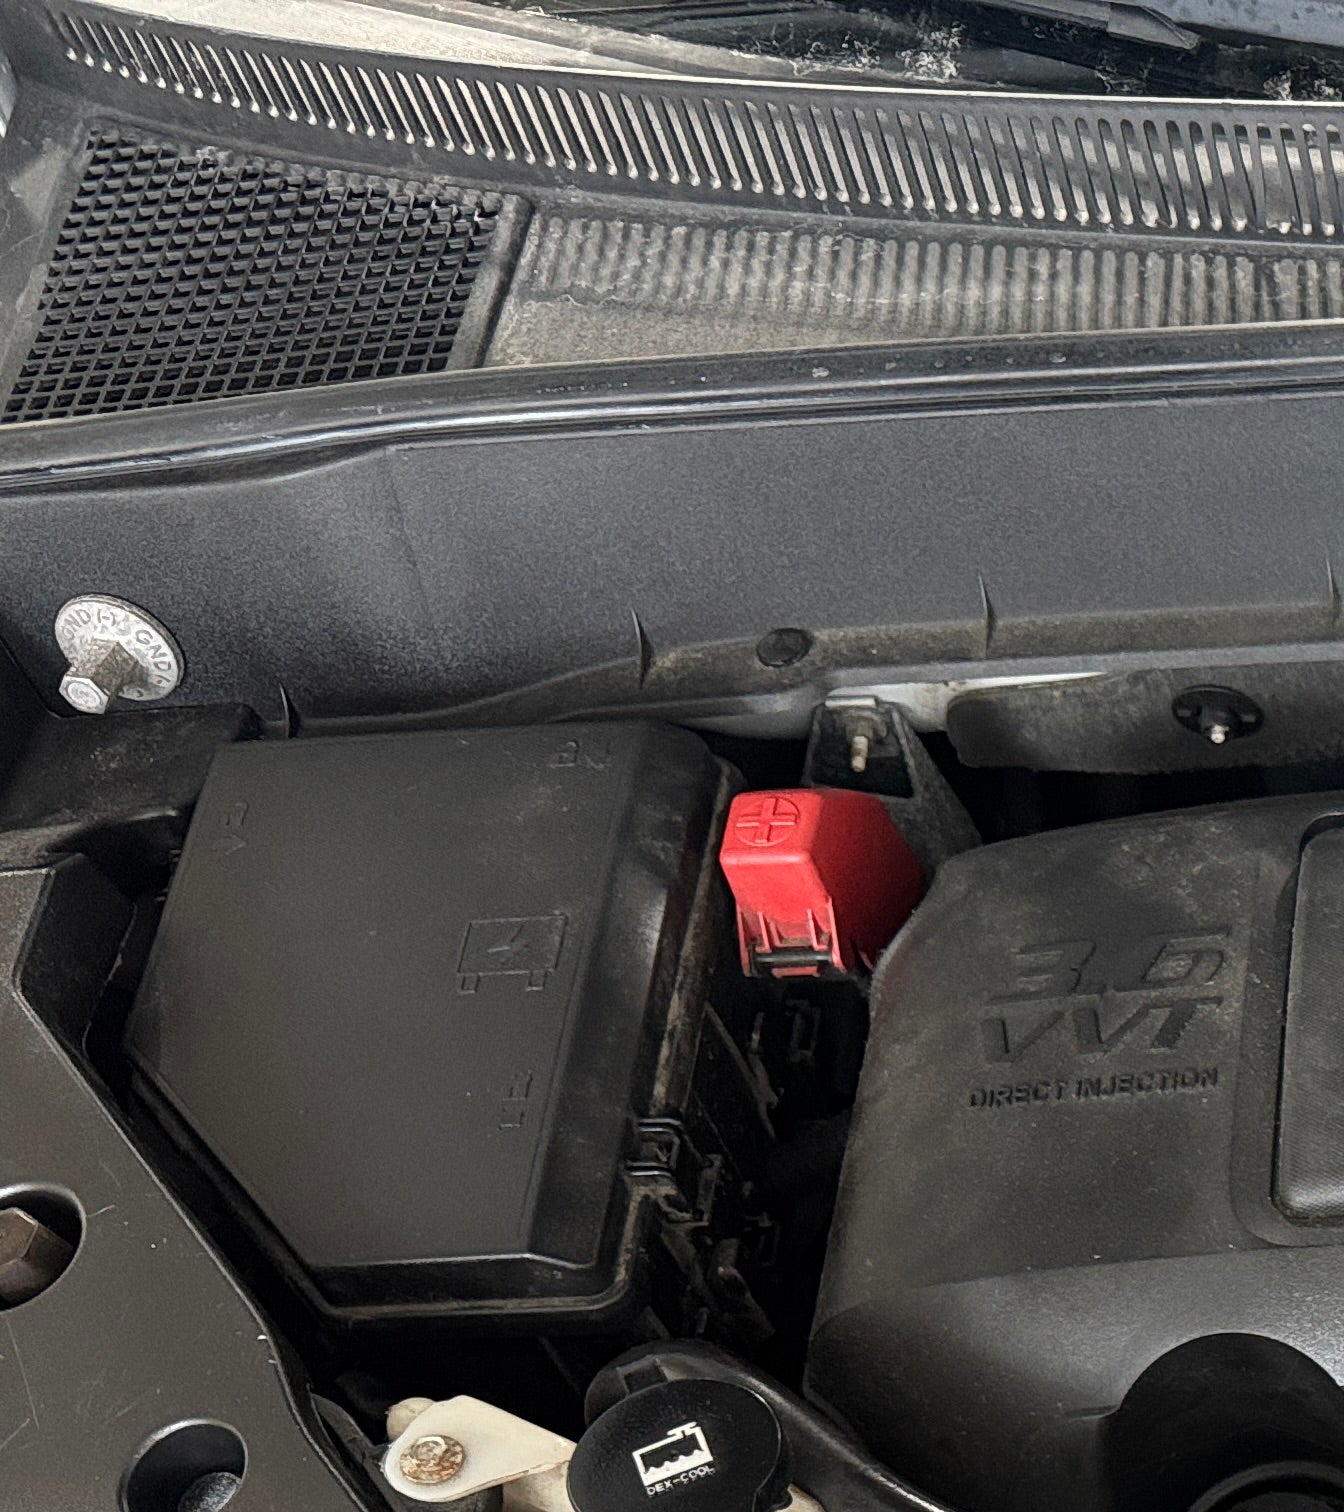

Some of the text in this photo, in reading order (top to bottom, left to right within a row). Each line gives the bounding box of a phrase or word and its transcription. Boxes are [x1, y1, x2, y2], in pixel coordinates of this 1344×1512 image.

[980, 997, 1225, 1063] VVT
[969, 1067, 1219, 1109] DIRECT INJECTION
[646, 1465, 716, 1497] DEX-COOL
